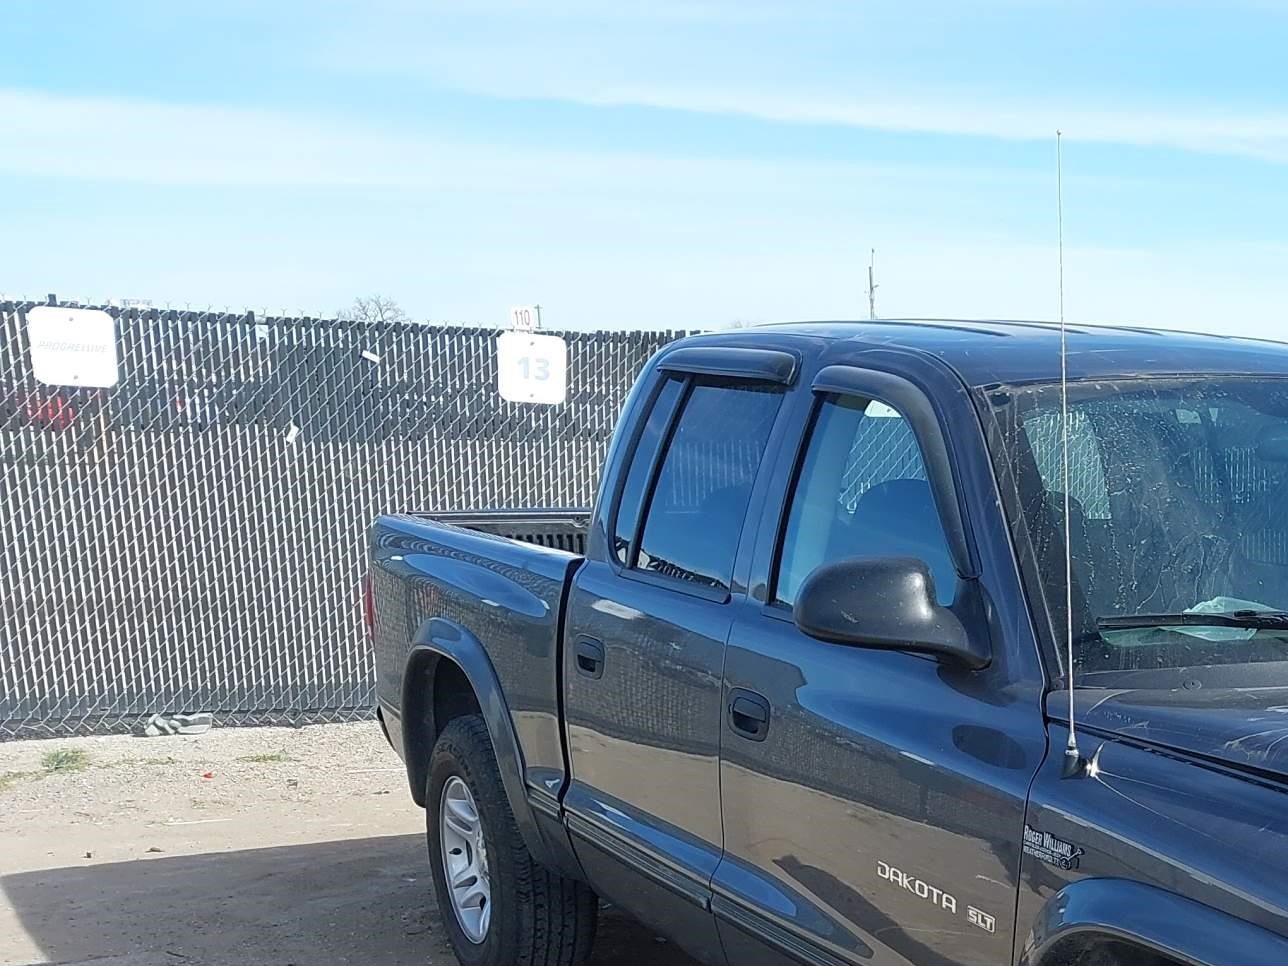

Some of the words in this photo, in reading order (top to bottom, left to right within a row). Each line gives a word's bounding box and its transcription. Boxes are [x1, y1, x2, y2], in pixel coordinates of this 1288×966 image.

[514, 309, 530, 326] 110
[517, 357, 550, 381] 13
[1023, 824, 1043, 846] ROGER
[1043, 831, 1072, 857] WILLIAMS
[877, 860, 957, 914] DAKOTA
[967, 907, 994, 931] SLT
